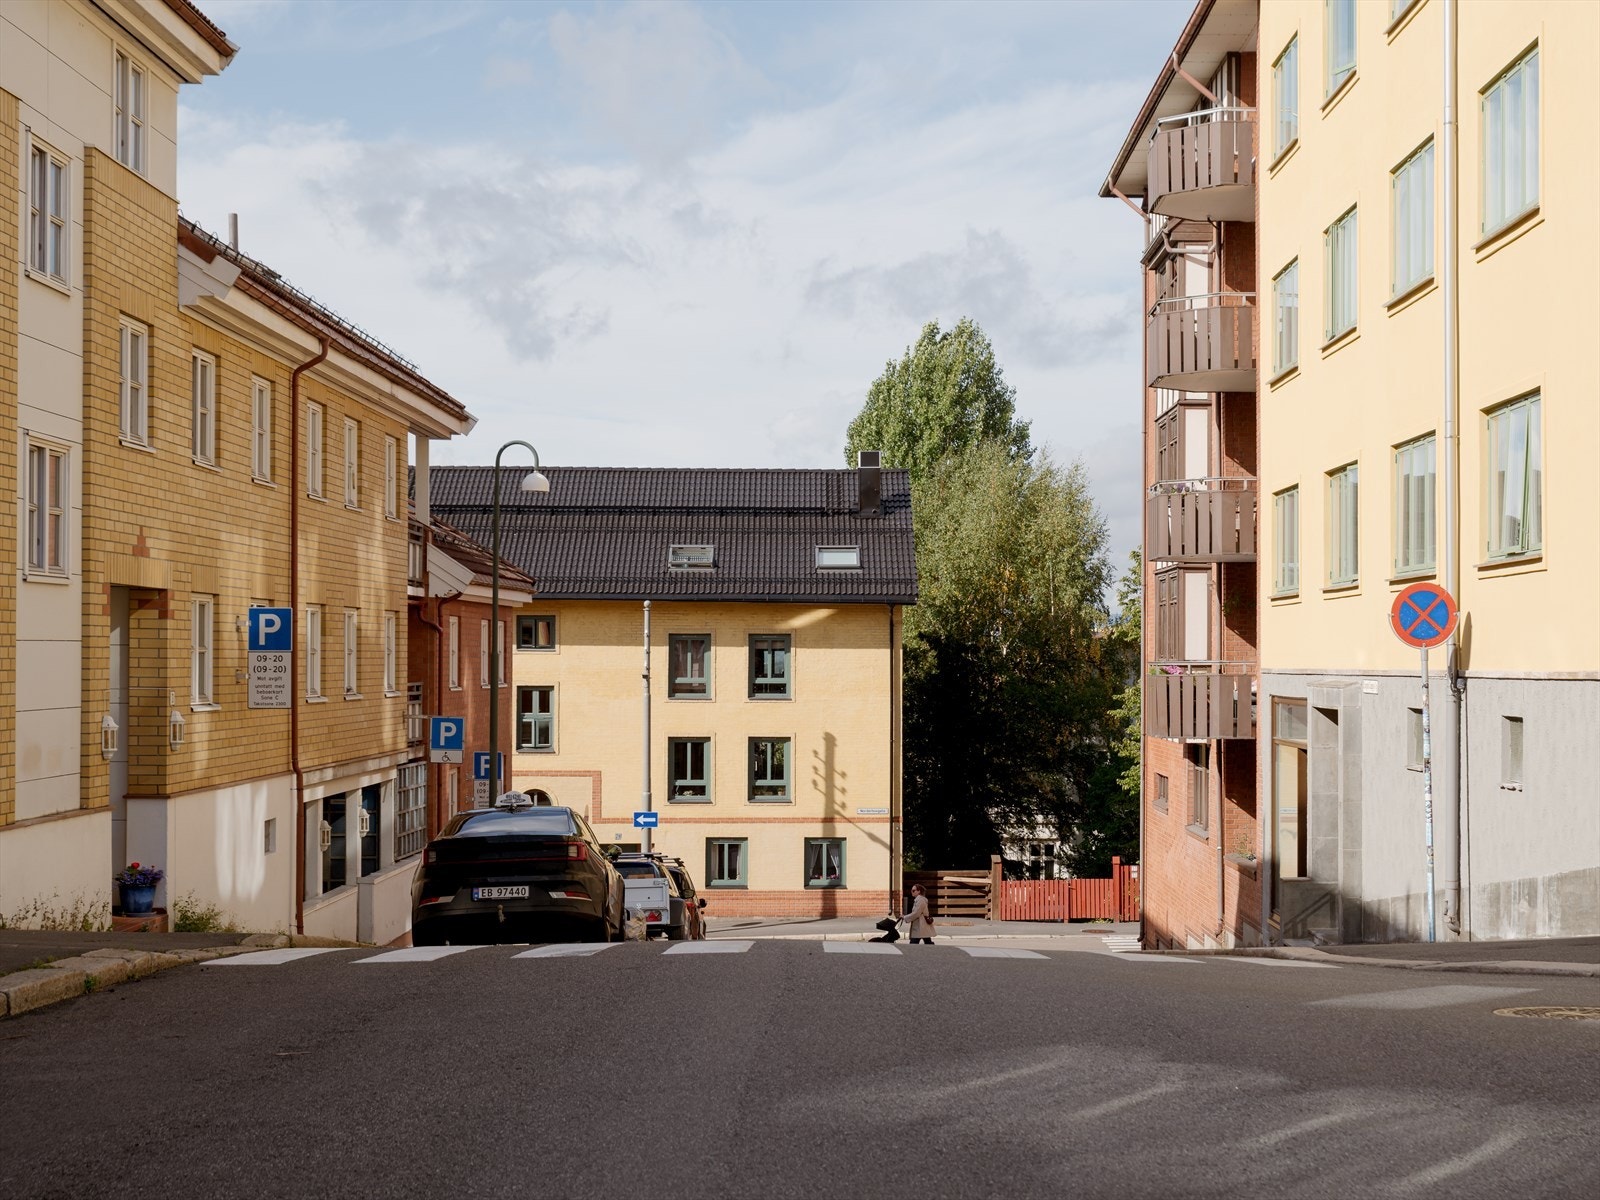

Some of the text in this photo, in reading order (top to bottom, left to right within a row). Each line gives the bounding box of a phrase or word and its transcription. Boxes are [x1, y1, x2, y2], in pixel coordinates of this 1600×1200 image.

[259, 613, 281, 645] P
[440, 722, 456, 746] P
[481, 887, 526, 898] EB 97440
